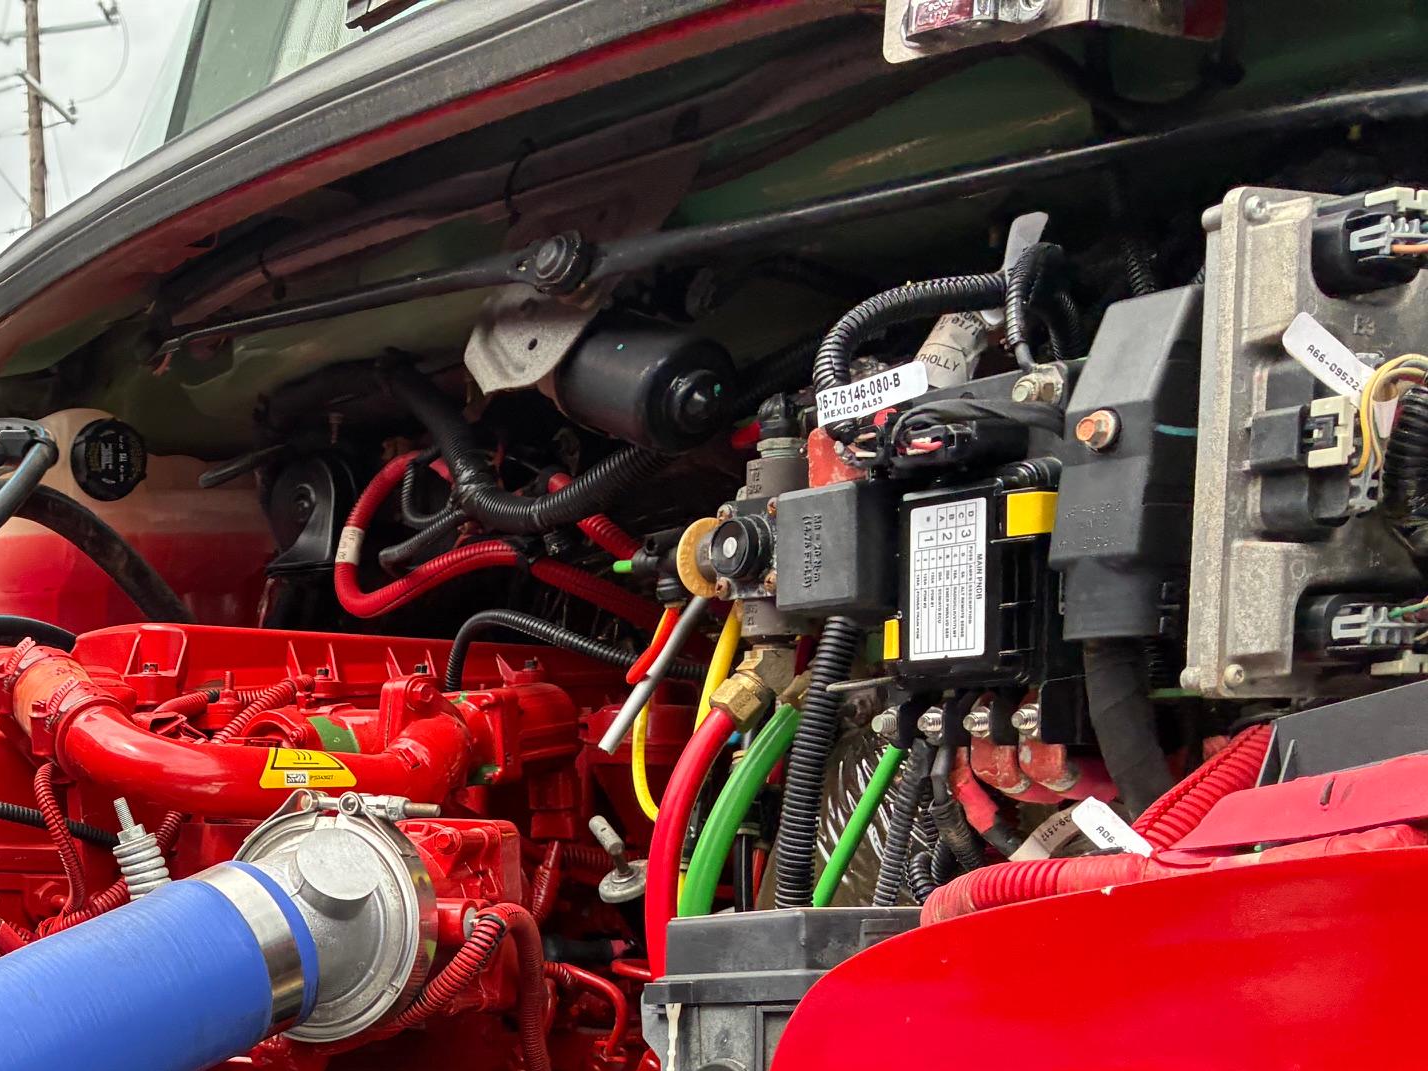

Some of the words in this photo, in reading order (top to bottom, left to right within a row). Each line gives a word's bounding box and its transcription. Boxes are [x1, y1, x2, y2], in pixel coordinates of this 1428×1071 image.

[823, 404, 860, 420] MEXICO
[923, 535, 935, 543] 1
[942, 531, 953, 542] 2
[960, 528, 972, 539] 3
